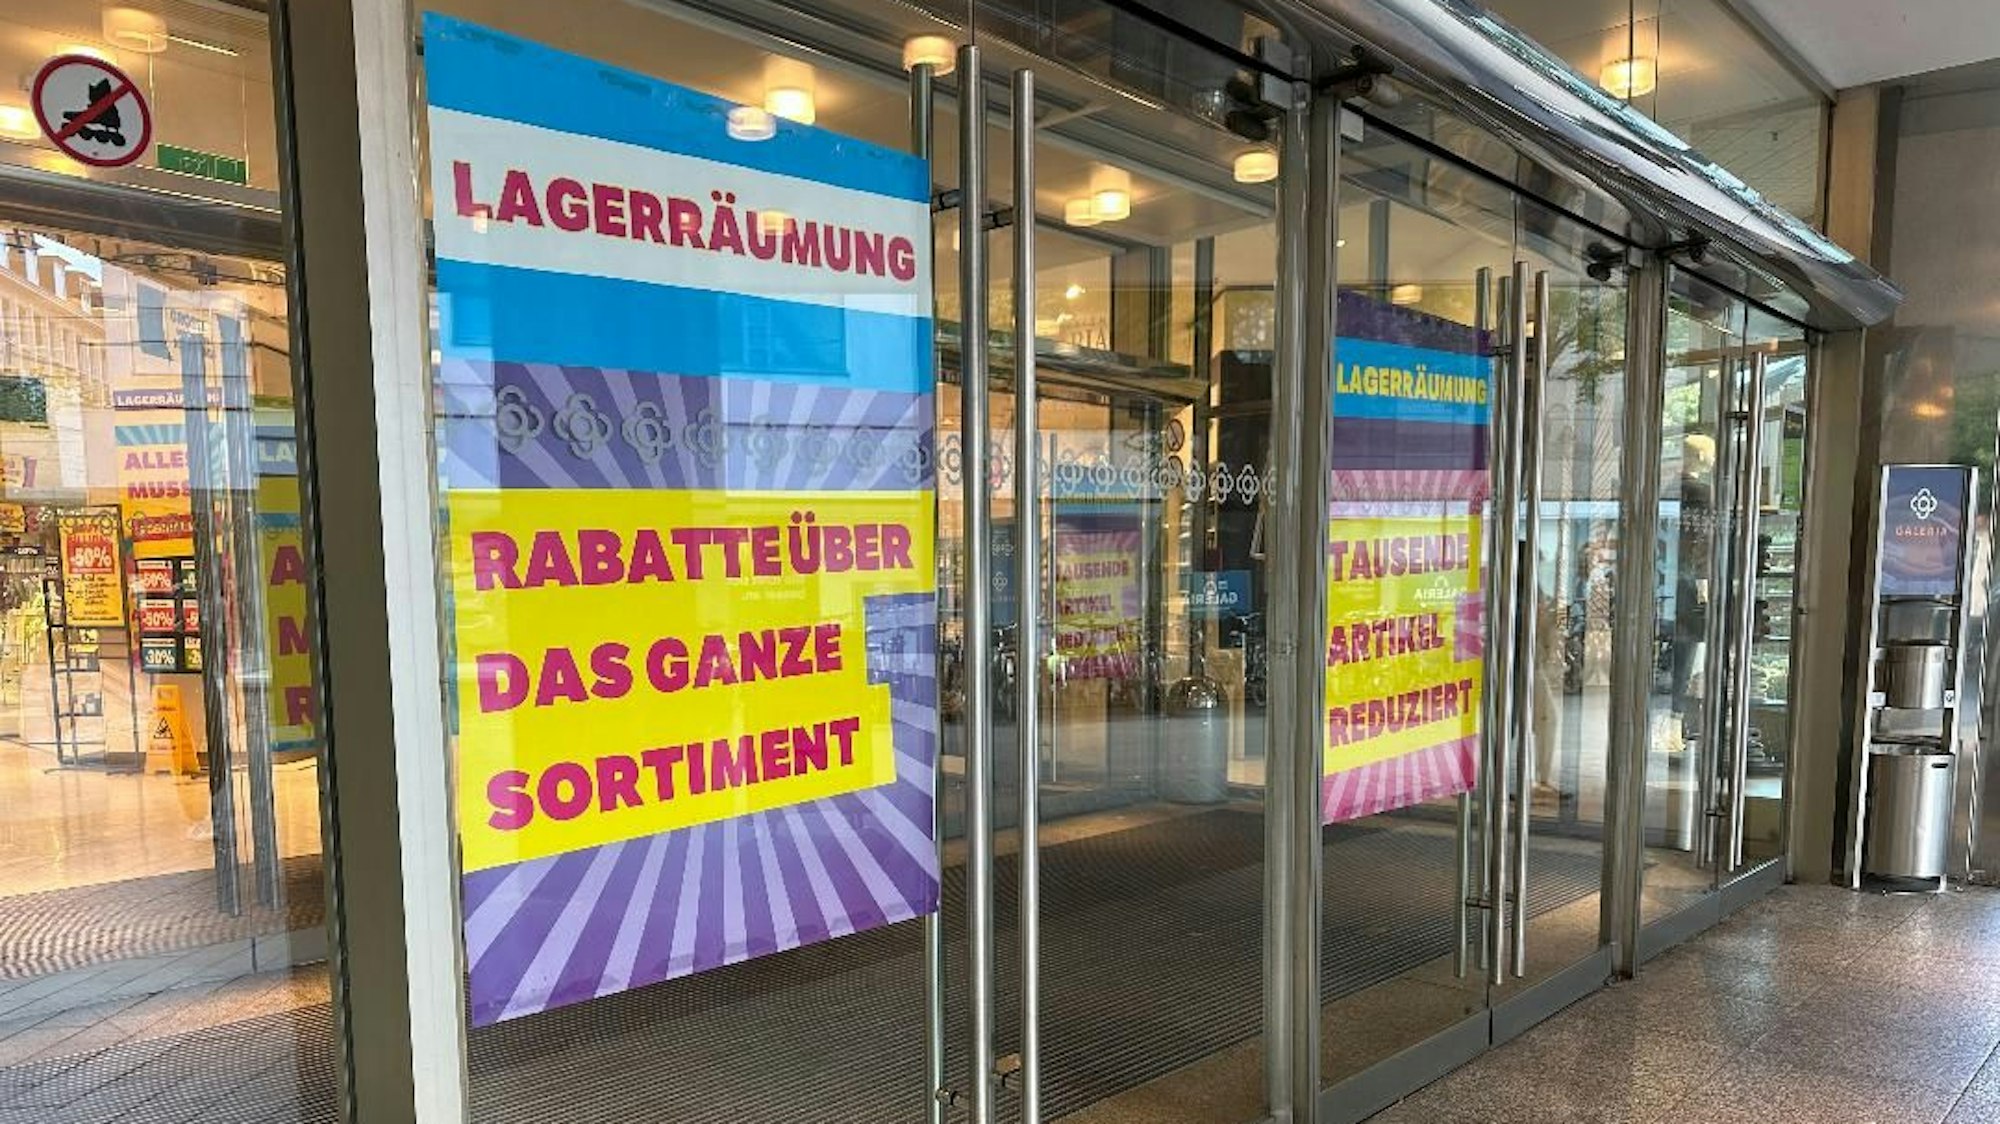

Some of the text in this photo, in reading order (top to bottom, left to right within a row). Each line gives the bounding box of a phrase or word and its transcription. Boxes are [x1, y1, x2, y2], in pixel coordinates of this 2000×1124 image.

[452, 160, 917, 282] LAGERRÄUMUNG
[1336, 361, 1488, 405] LAGERRÄUMUNG
[124, 451, 189, 470] ALLE
[69, 547, 113, 568] -50%
[471, 510, 914, 592] RABATTE ÜBER
[1329, 533, 1469, 582] TAUSENDE
[475, 622, 843, 714] DAS GANZE
[1328, 613, 1445, 666] ARTIKEL
[1329, 678, 1473, 747] REDUZIERT
[486, 716, 861, 831] SORTIMENT
